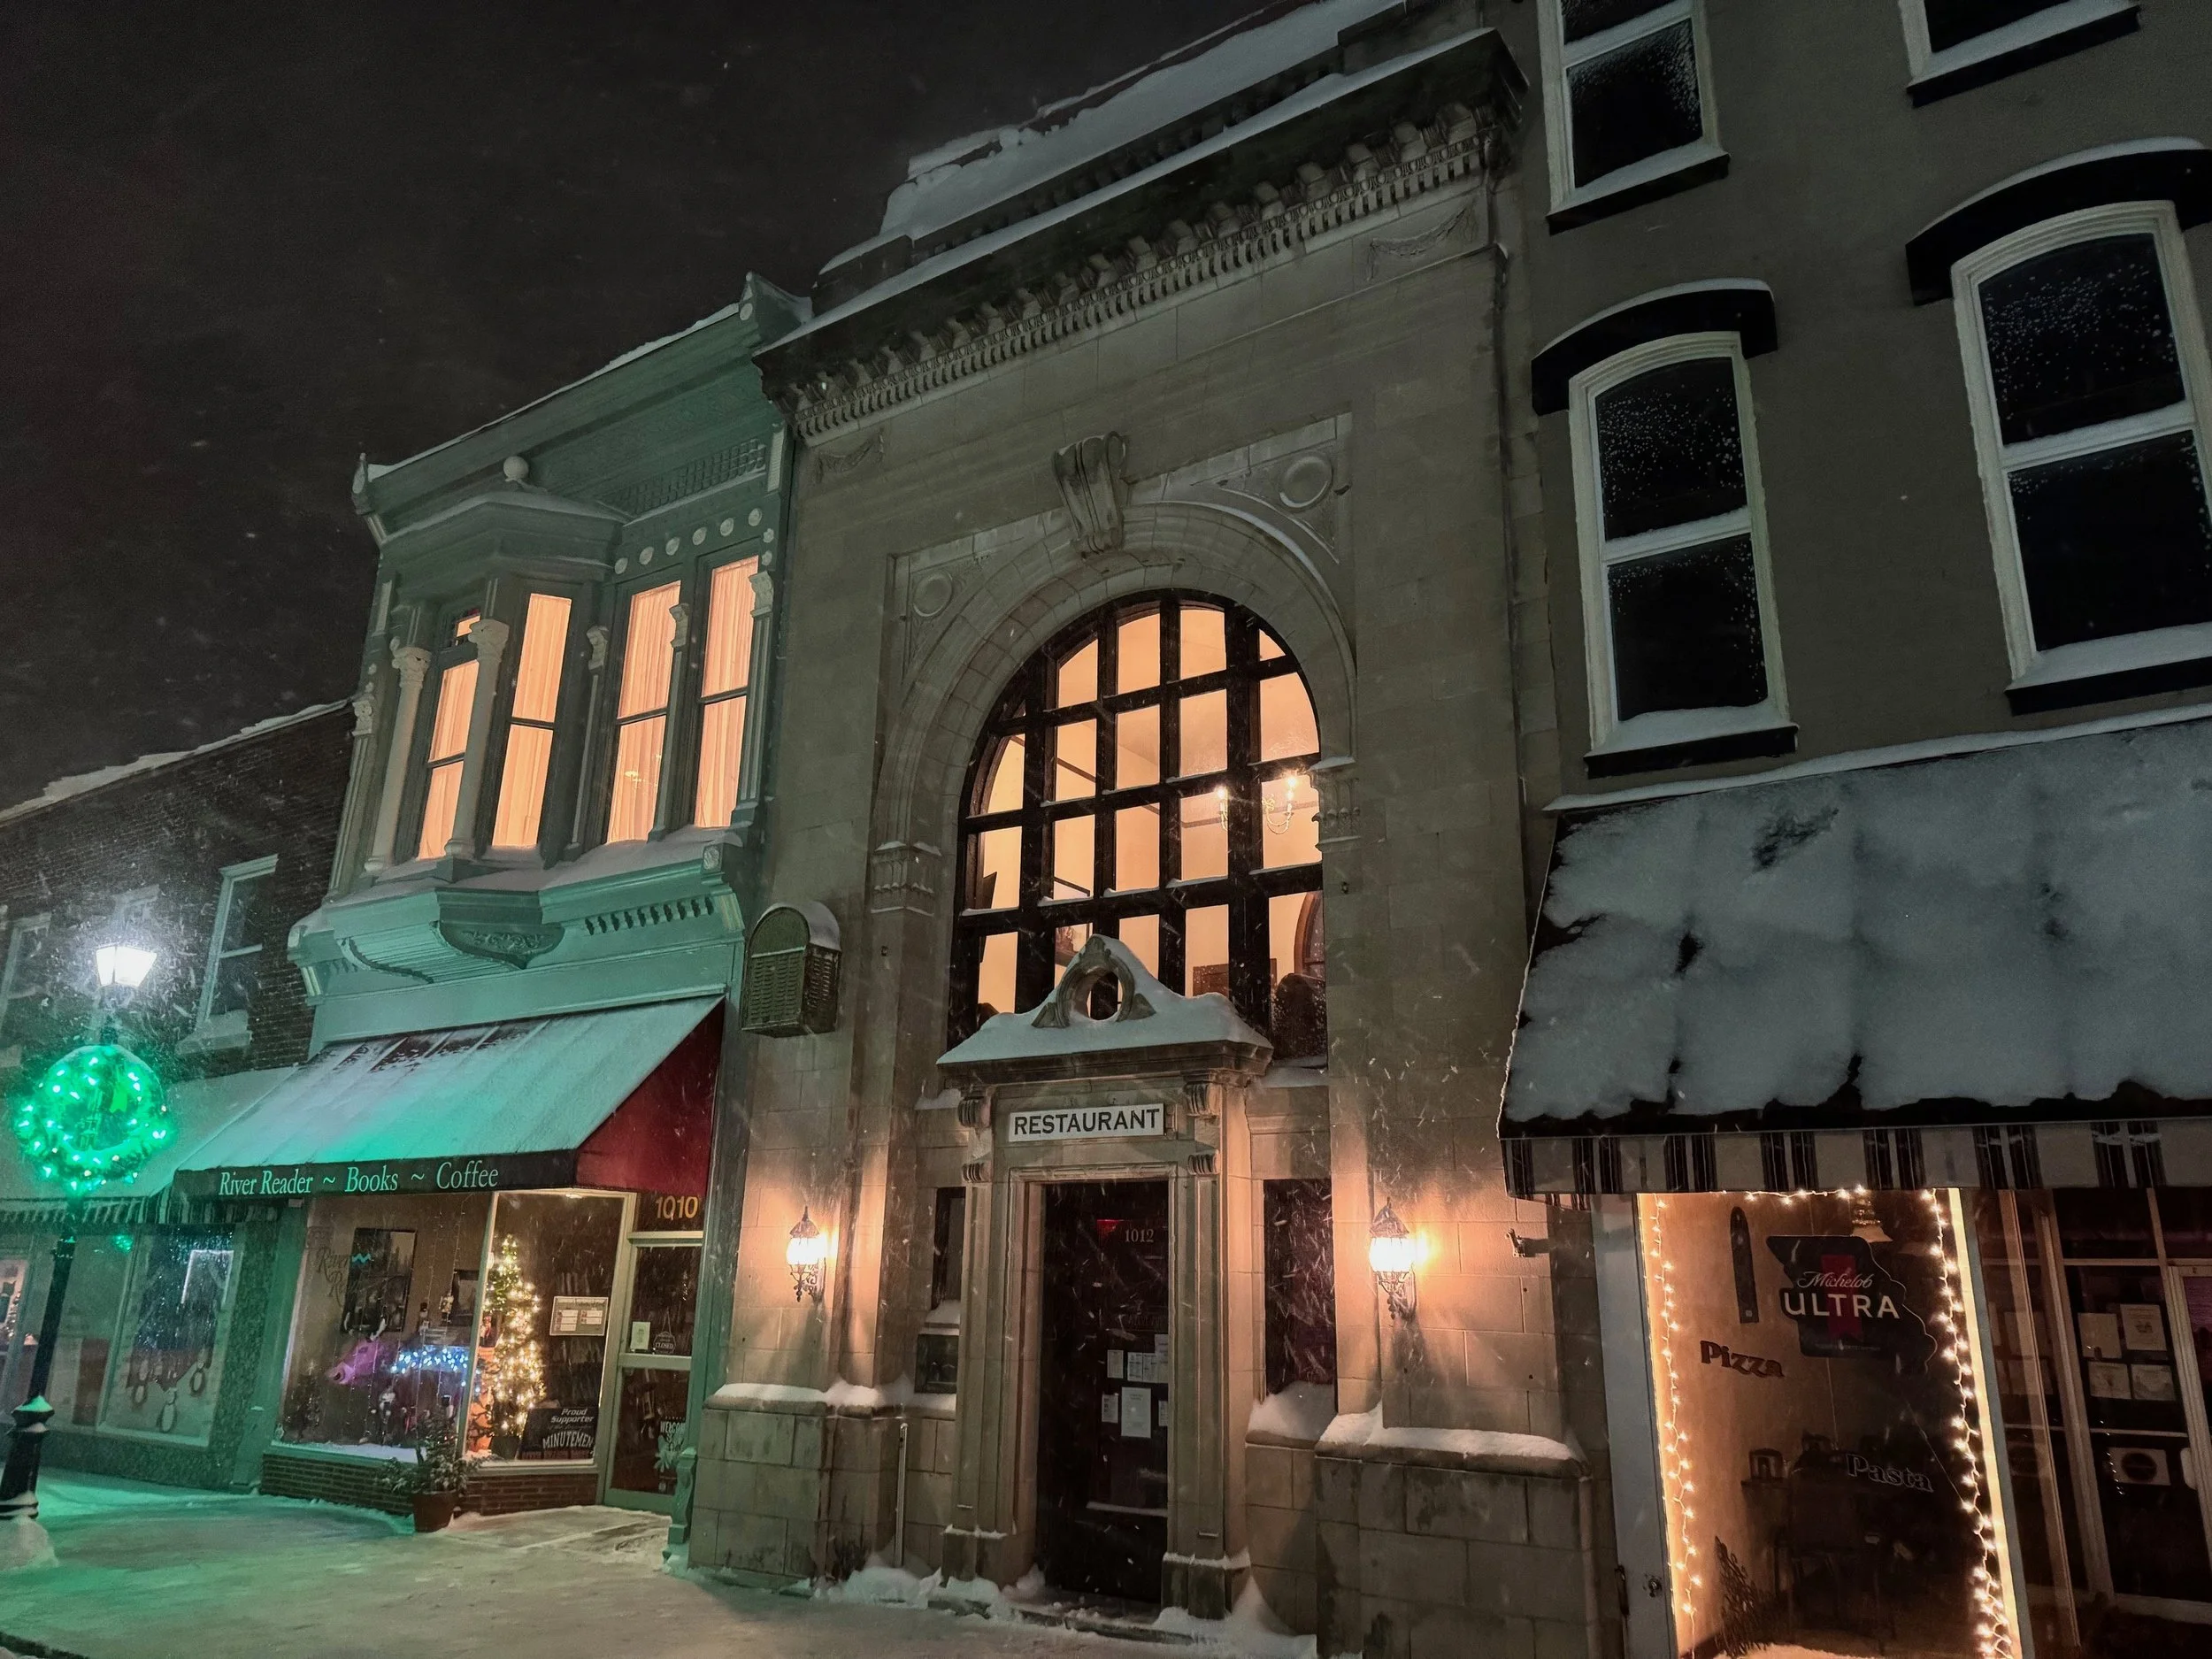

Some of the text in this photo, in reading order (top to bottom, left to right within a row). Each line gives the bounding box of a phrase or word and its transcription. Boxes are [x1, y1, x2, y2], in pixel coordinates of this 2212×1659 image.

[1014, 1108, 1160, 1135] RESTAURANT
[219, 1171, 257, 1195] River
[259, 1168, 314, 1194] Reader
[344, 1164, 398, 1193] Books
[436, 1160, 499, 1190] Coffee
[656, 1195, 698, 1219] 1010
[1125, 1228, 1155, 1243] 1012
[1797, 1270, 1875, 1288] Michelob
[1784, 1292, 1901, 1319] ULTRA
[1700, 1340, 1786, 1378] Pizza
[550, 1416, 595, 1425] Supporter
[542, 1431, 595, 1449] MINUTEMEN
[1847, 1454, 1934, 1493] Pasta
